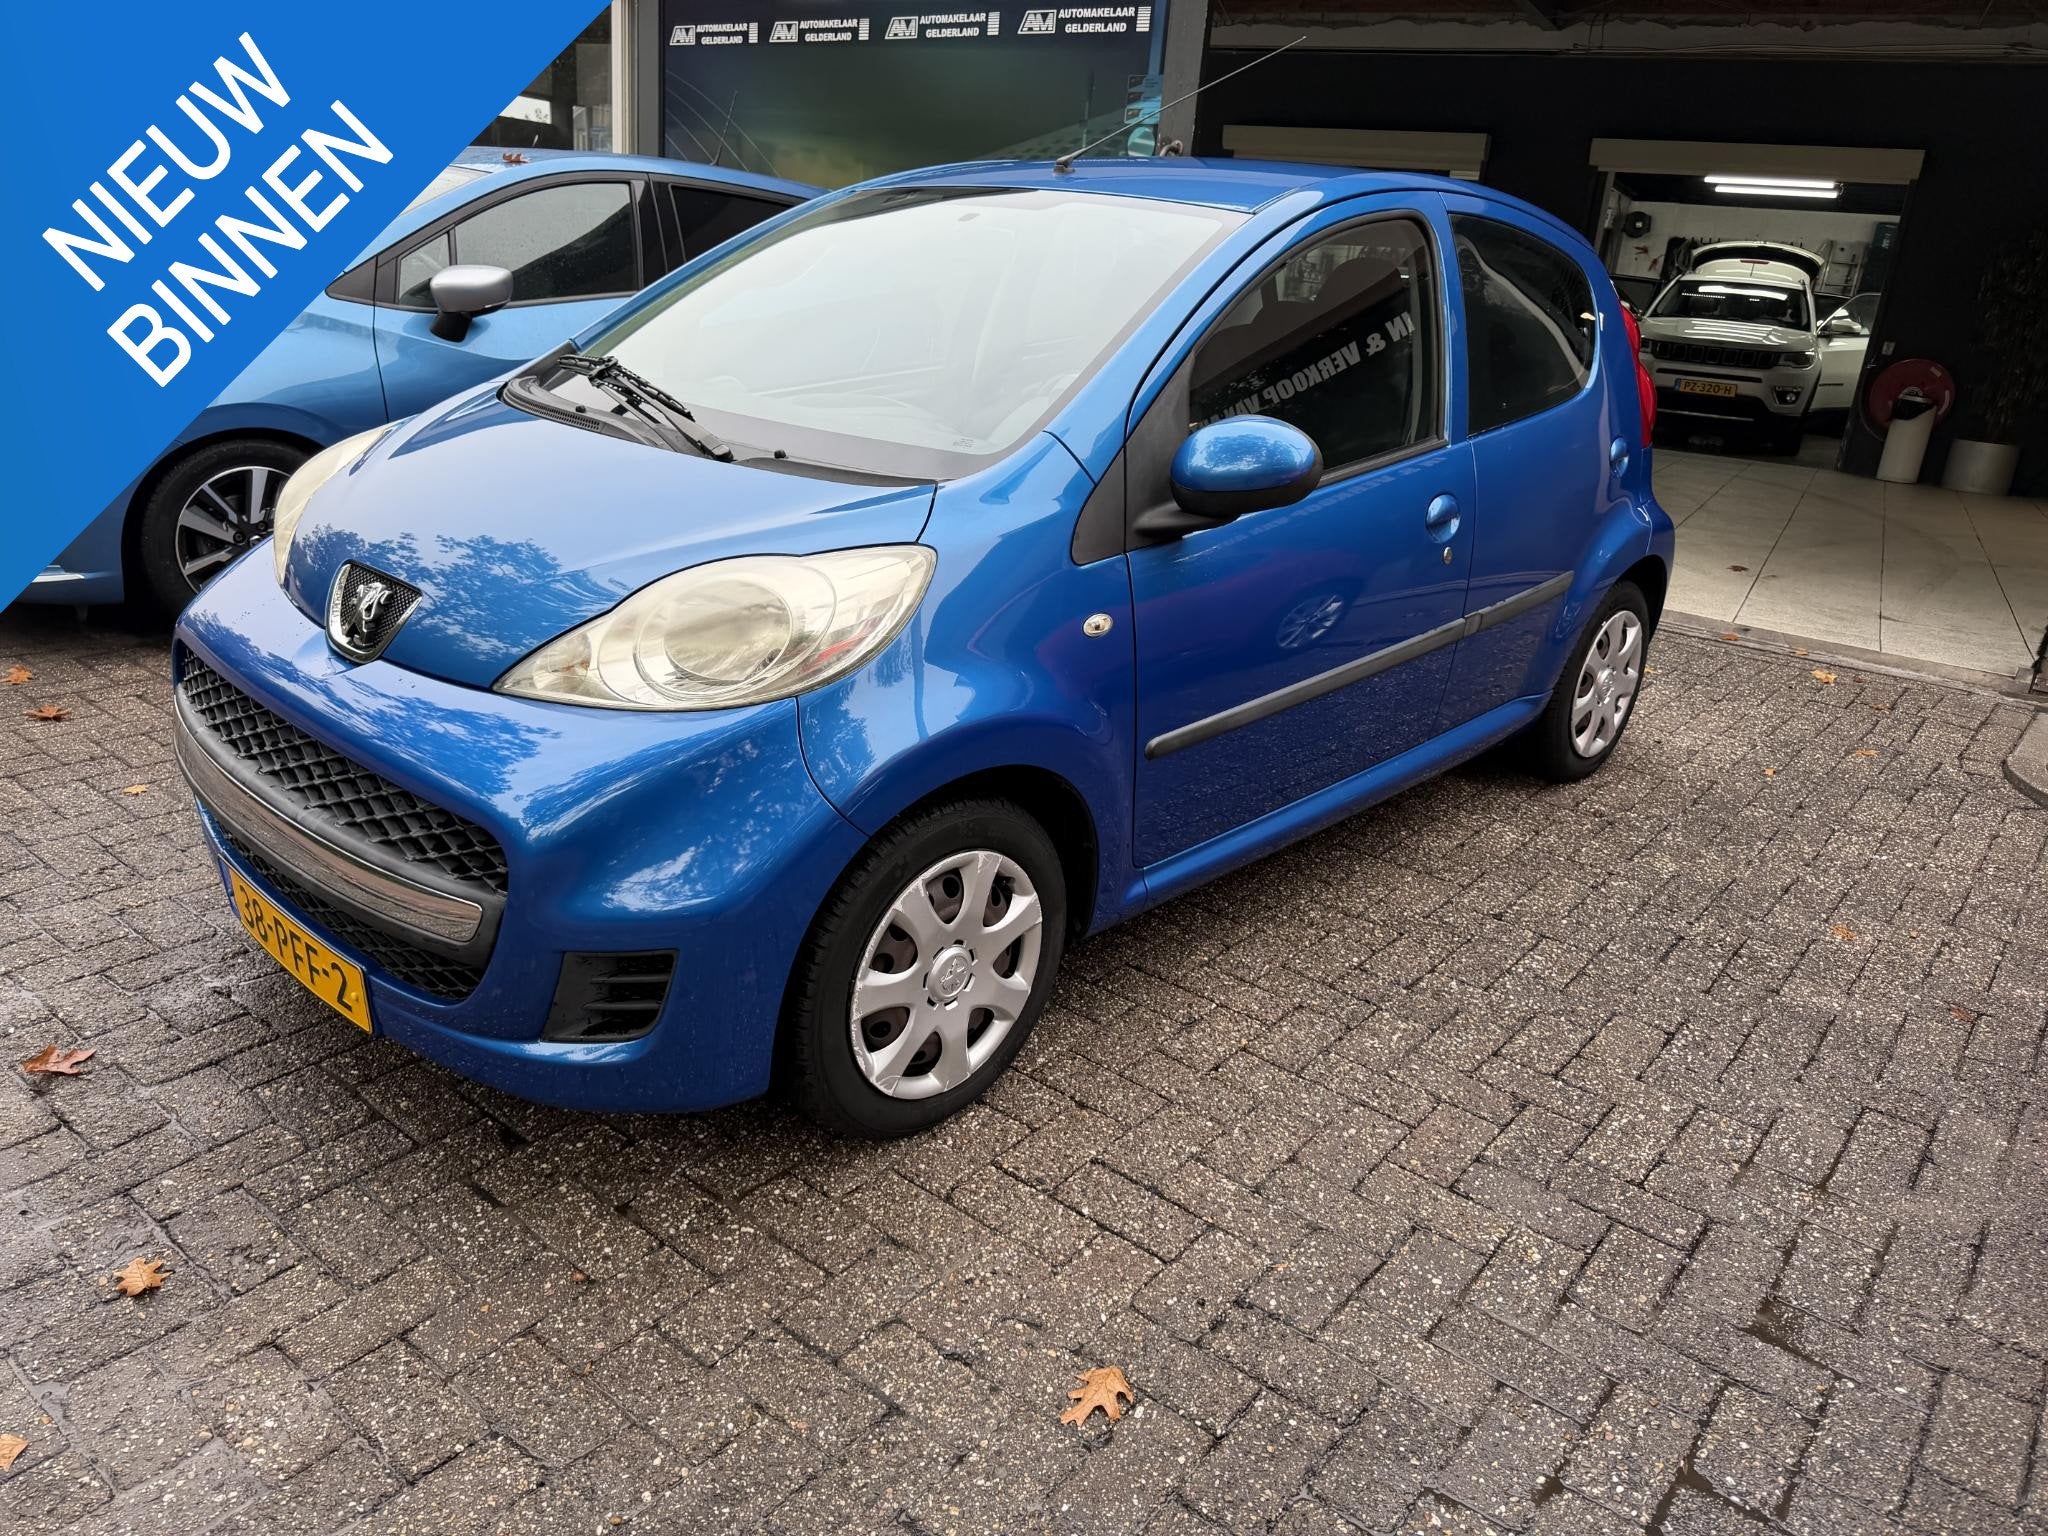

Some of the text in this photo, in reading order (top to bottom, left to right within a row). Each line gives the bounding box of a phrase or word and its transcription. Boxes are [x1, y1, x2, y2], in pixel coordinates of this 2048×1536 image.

[1058, 6, 1135, 19] AUTOMAKELAAR
[800, 18, 858, 29] AUTOMAKELAAR
[919, 12, 986, 25] AUTOMAKELAAR
[696, 23, 748, 33] AUTOMAKELAAR
[925, 27, 980, 38] GELDERLAND
[1065, 22, 1127, 33] GELDERLAND
[701, 35, 743, 45] GELDERLAND
[805, 32, 852, 42] GELDERLAND
[1683, 381, 1732, 395] PZ-320-H
[239, 885, 353, 1013] 38-PFF-2
